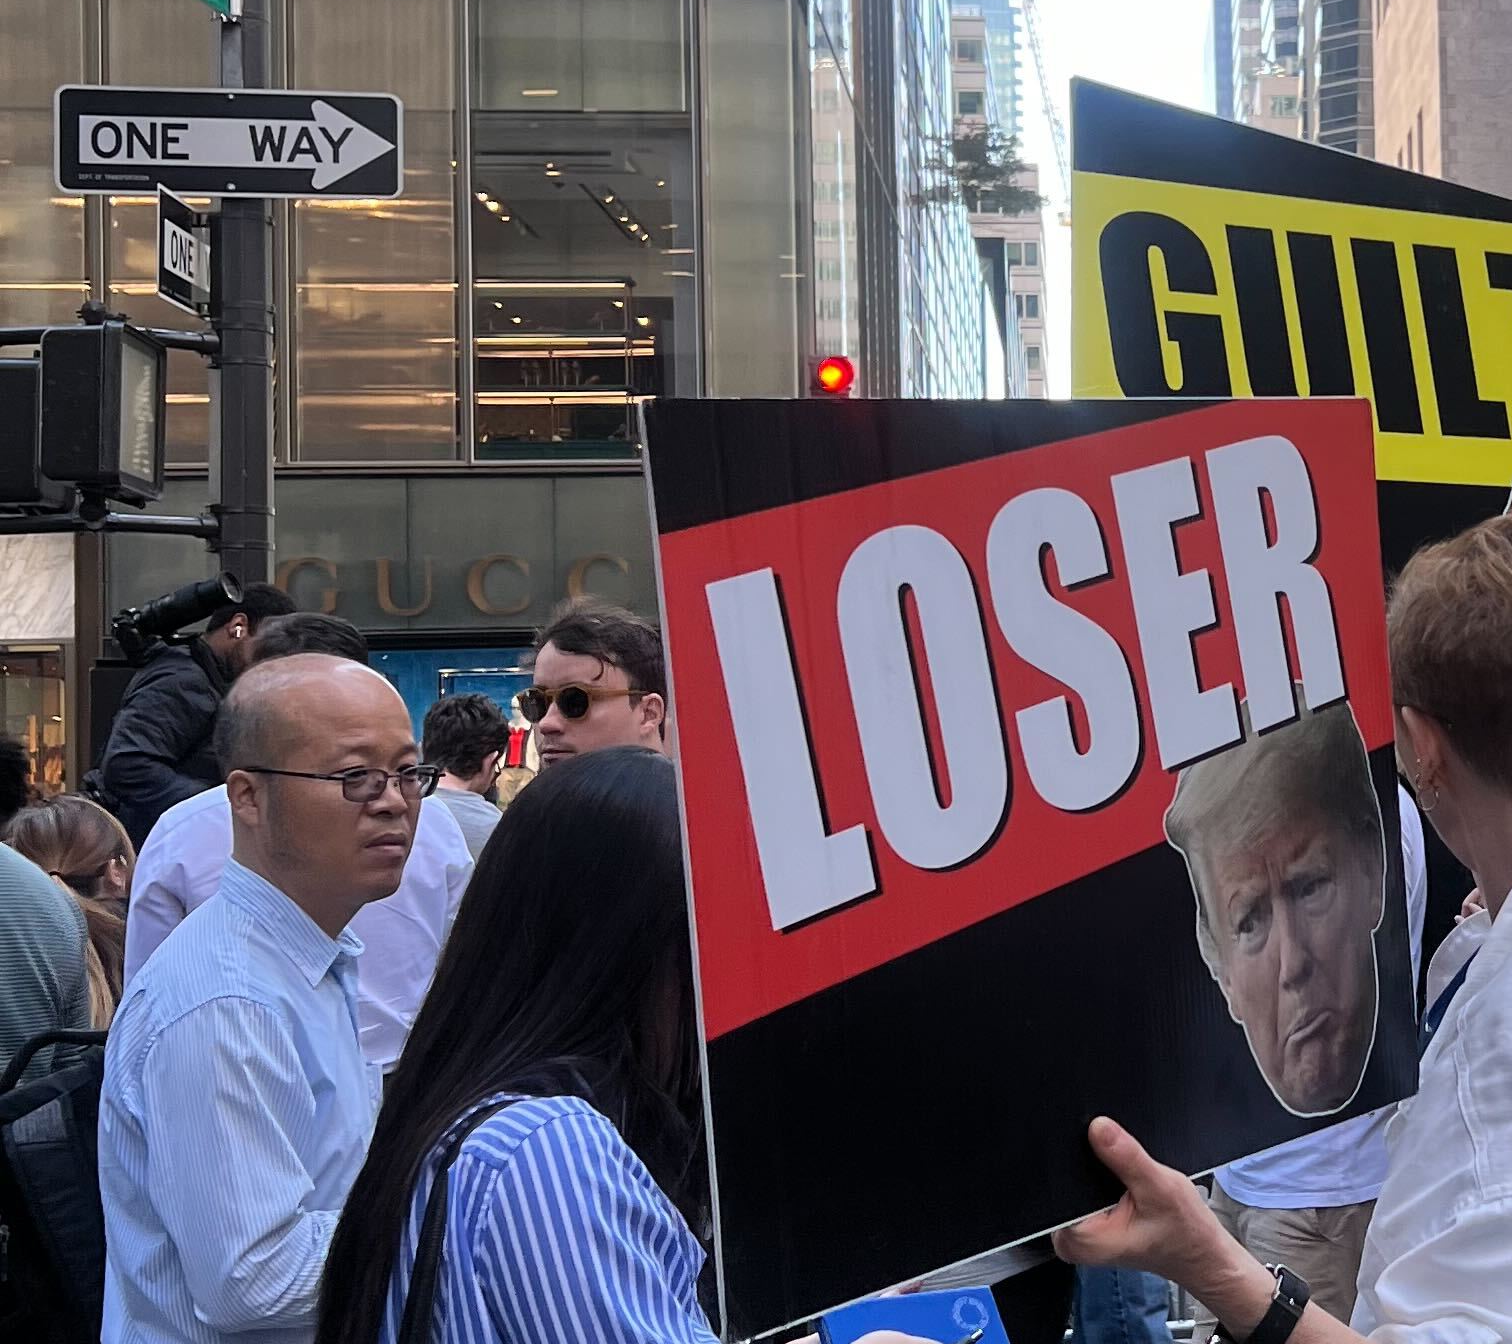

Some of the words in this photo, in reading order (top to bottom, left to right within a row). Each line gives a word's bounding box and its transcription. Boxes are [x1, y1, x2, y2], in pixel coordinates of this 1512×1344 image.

[91, 121, 190, 160] ONE
[249, 124, 353, 164] WAY
[170, 230, 195, 278] ONE
[704, 434, 1349, 935] LOSER
